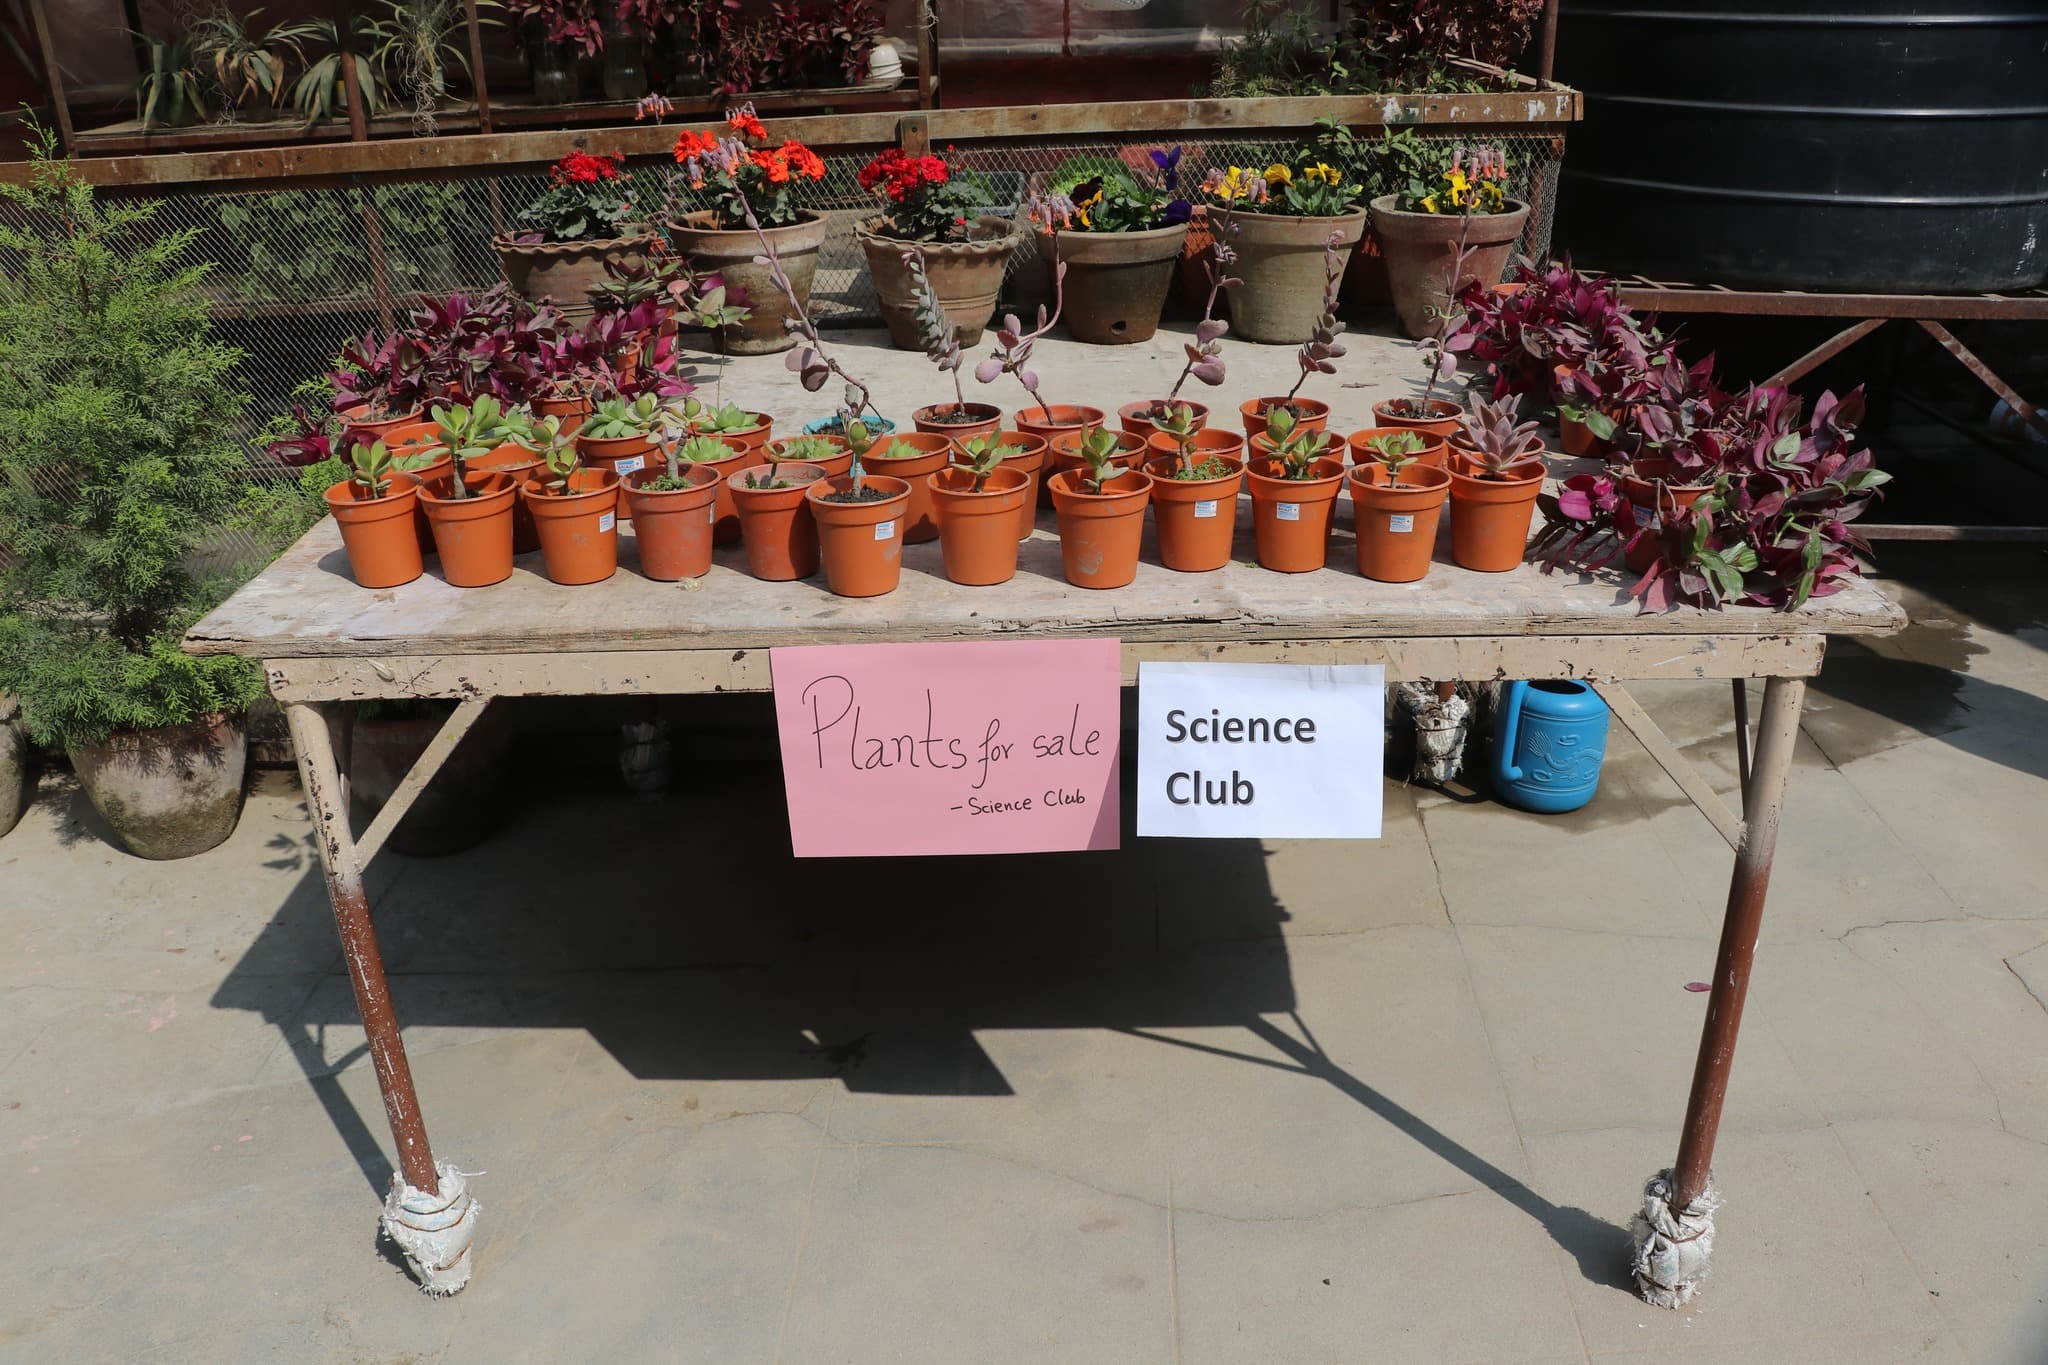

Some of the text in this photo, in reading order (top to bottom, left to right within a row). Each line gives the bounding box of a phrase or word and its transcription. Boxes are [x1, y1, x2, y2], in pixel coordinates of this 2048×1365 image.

[801, 675, 1100, 790] Plants for sale
[1165, 708, 1316, 744] Science
[1043, 787, 1086, 807] Club
[1166, 770, 1255, 806] Club
